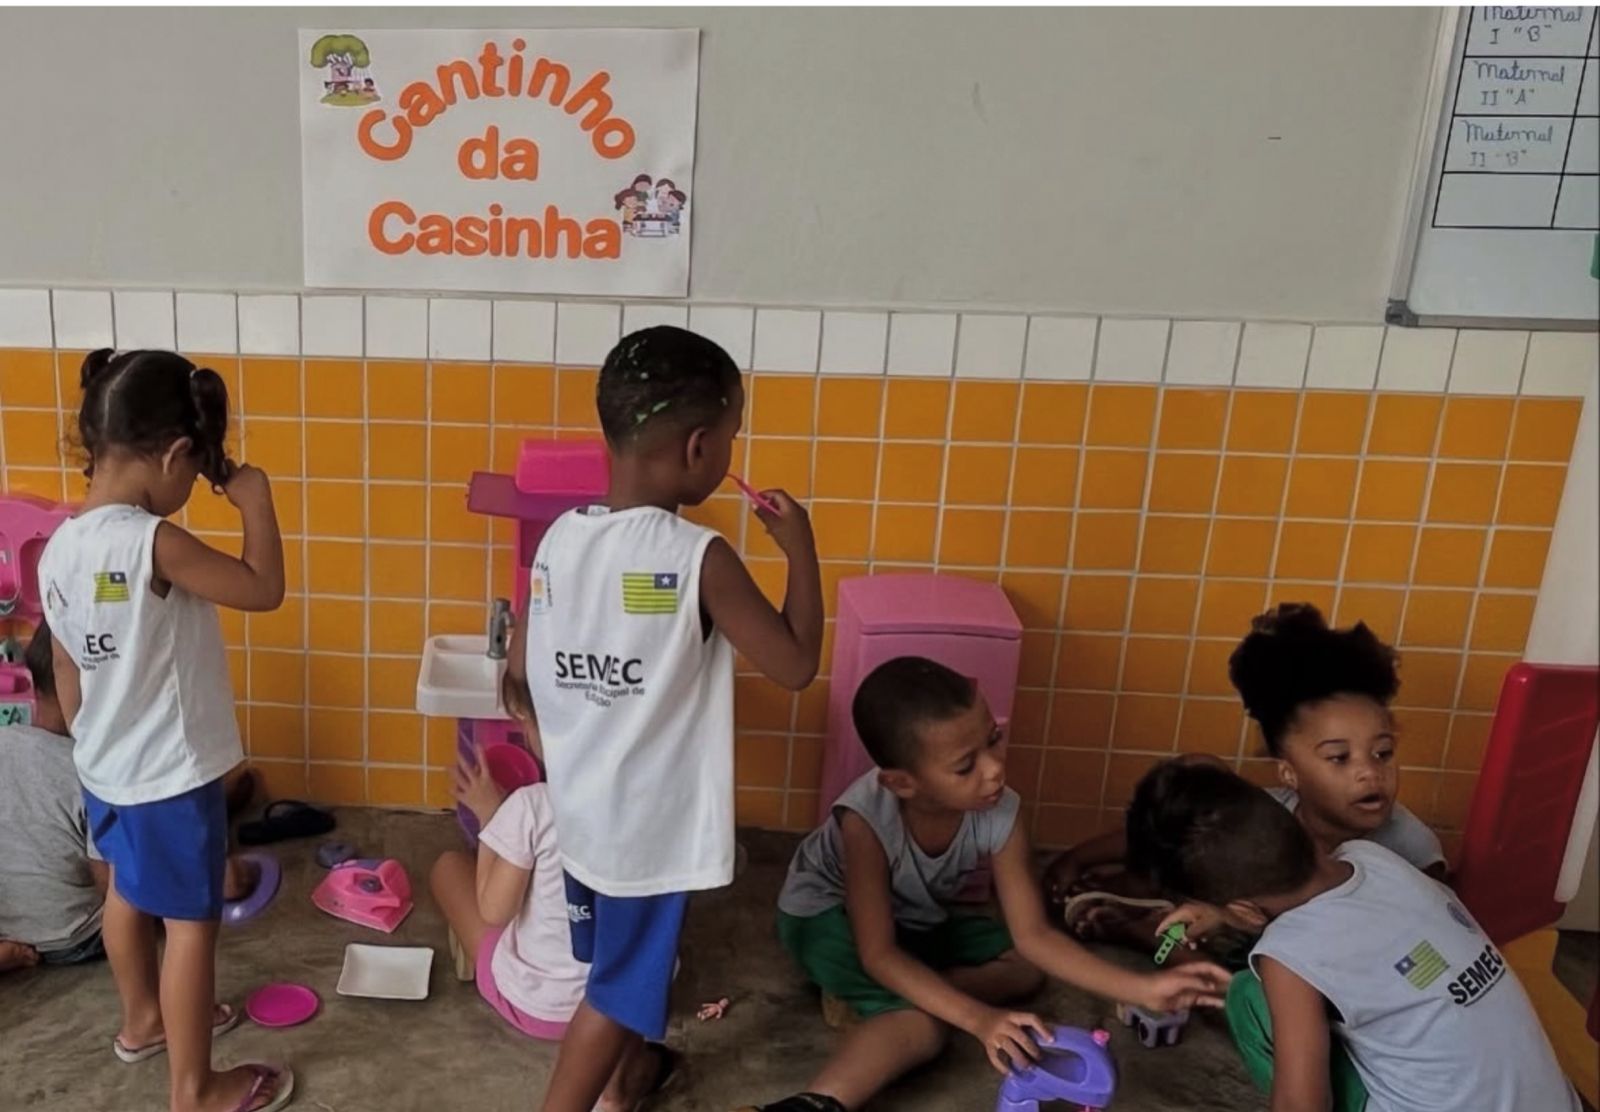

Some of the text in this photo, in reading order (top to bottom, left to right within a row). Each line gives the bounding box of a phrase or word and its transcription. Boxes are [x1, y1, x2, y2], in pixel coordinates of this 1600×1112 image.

[1489, 28, 1500, 45] I
[357, 38, 636, 161] Cantinho
[1474, 60, 1565, 84] Maternal
[457, 125, 539, 181] da
[368, 200, 621, 259] Casinha
[555, 651, 644, 686] SEMEC
[1447, 944, 1503, 1005] SEMEC
